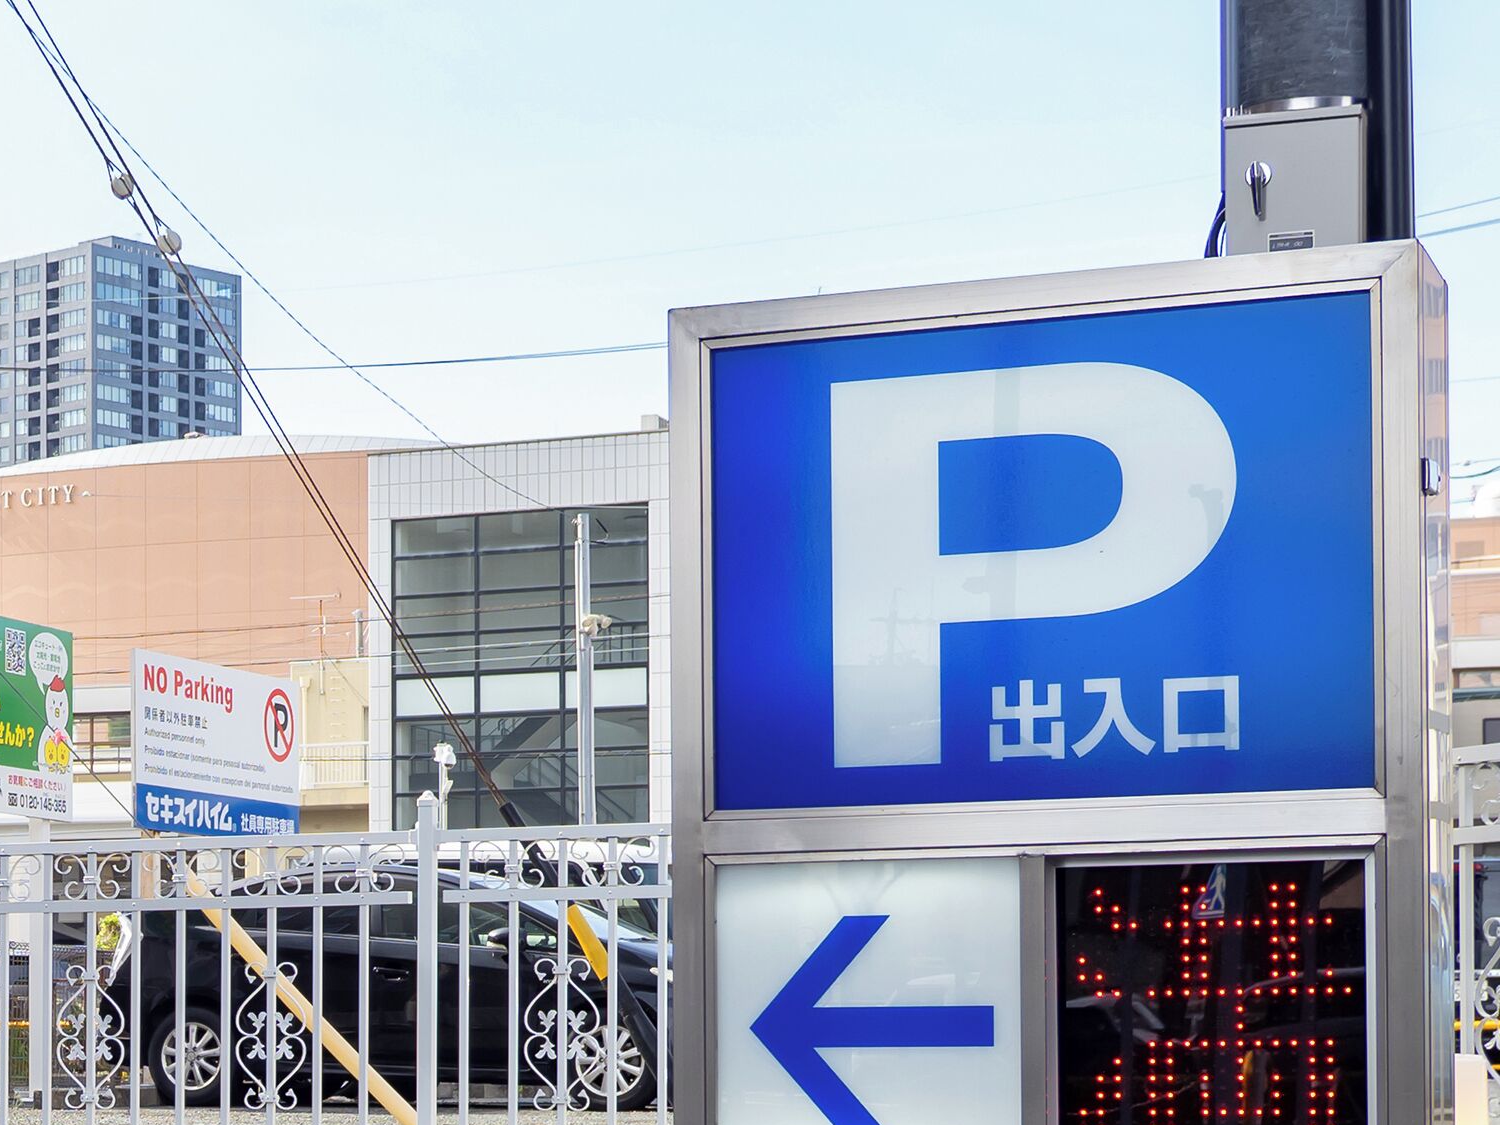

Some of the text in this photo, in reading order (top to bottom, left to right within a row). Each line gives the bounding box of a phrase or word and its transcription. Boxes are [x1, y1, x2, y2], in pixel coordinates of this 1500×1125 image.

[20, 484, 75, 508] CITY
[831, 361, 1238, 768] P
[144, 663, 233, 714] NO Parking
[988, 675, 1241, 763] 出入口
[145, 792, 233, 832] セキスイハイム
